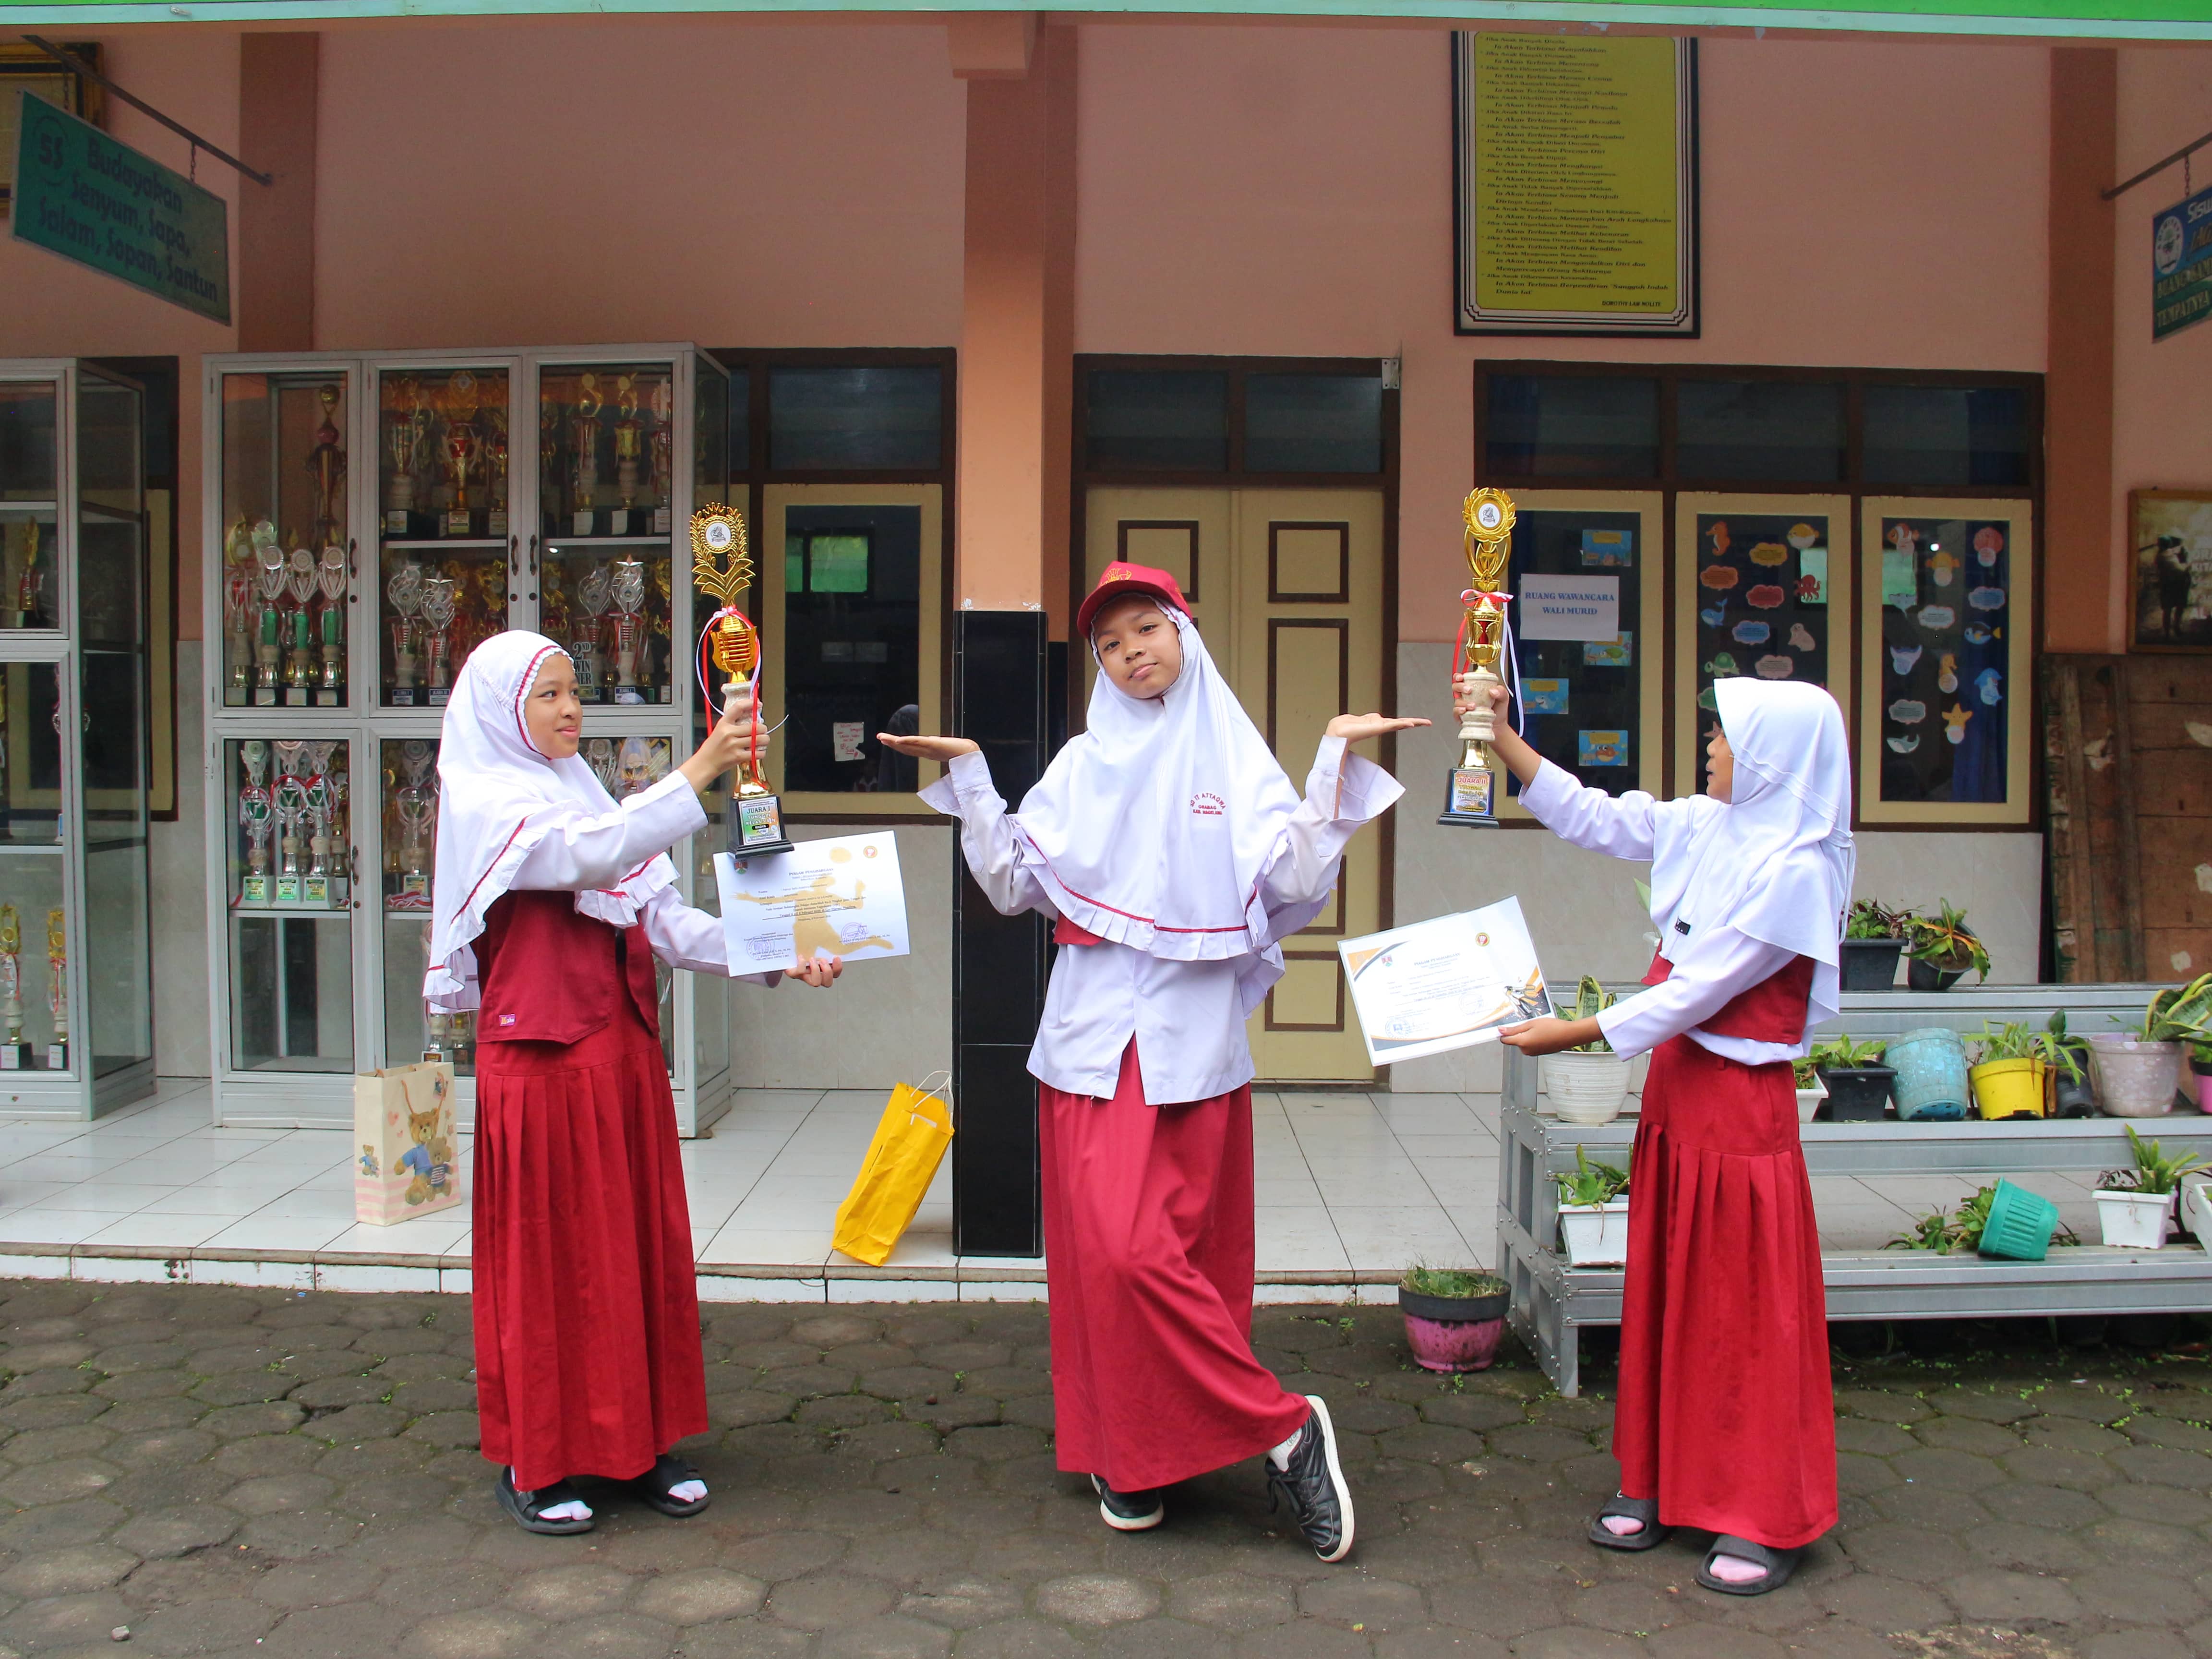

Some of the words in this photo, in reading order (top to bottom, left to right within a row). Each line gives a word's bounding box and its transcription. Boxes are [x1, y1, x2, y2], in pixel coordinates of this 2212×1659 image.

[72, 169, 143, 234] Senyum,
[149, 208, 191, 258] Sapa,
[88, 137, 182, 215] Budayakan
[39, 196, 101, 255] Salam,
[107, 228, 163, 281] Sopan,
[166, 255, 217, 302] Santun
[1557, 593, 1614, 601] WAWANCARA
